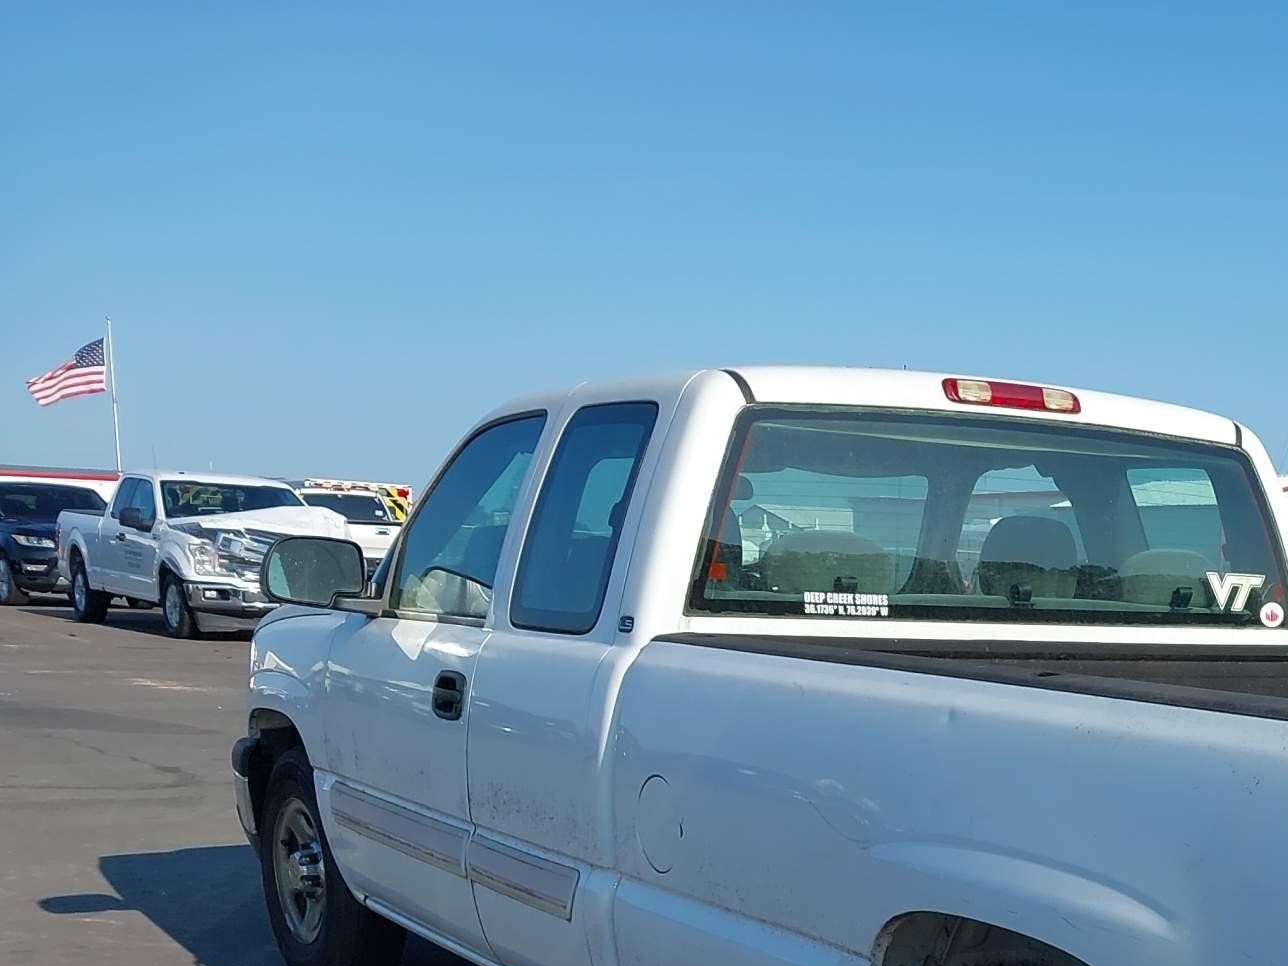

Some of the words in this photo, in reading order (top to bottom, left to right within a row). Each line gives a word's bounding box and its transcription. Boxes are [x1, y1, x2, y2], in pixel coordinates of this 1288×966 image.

[1206, 571, 1266, 612] VT
[804, 592, 826, 603] DEEP
[827, 592, 854, 604] CREEK
[854, 593, 889, 606] SHORES
[880, 606, 889, 616] W
